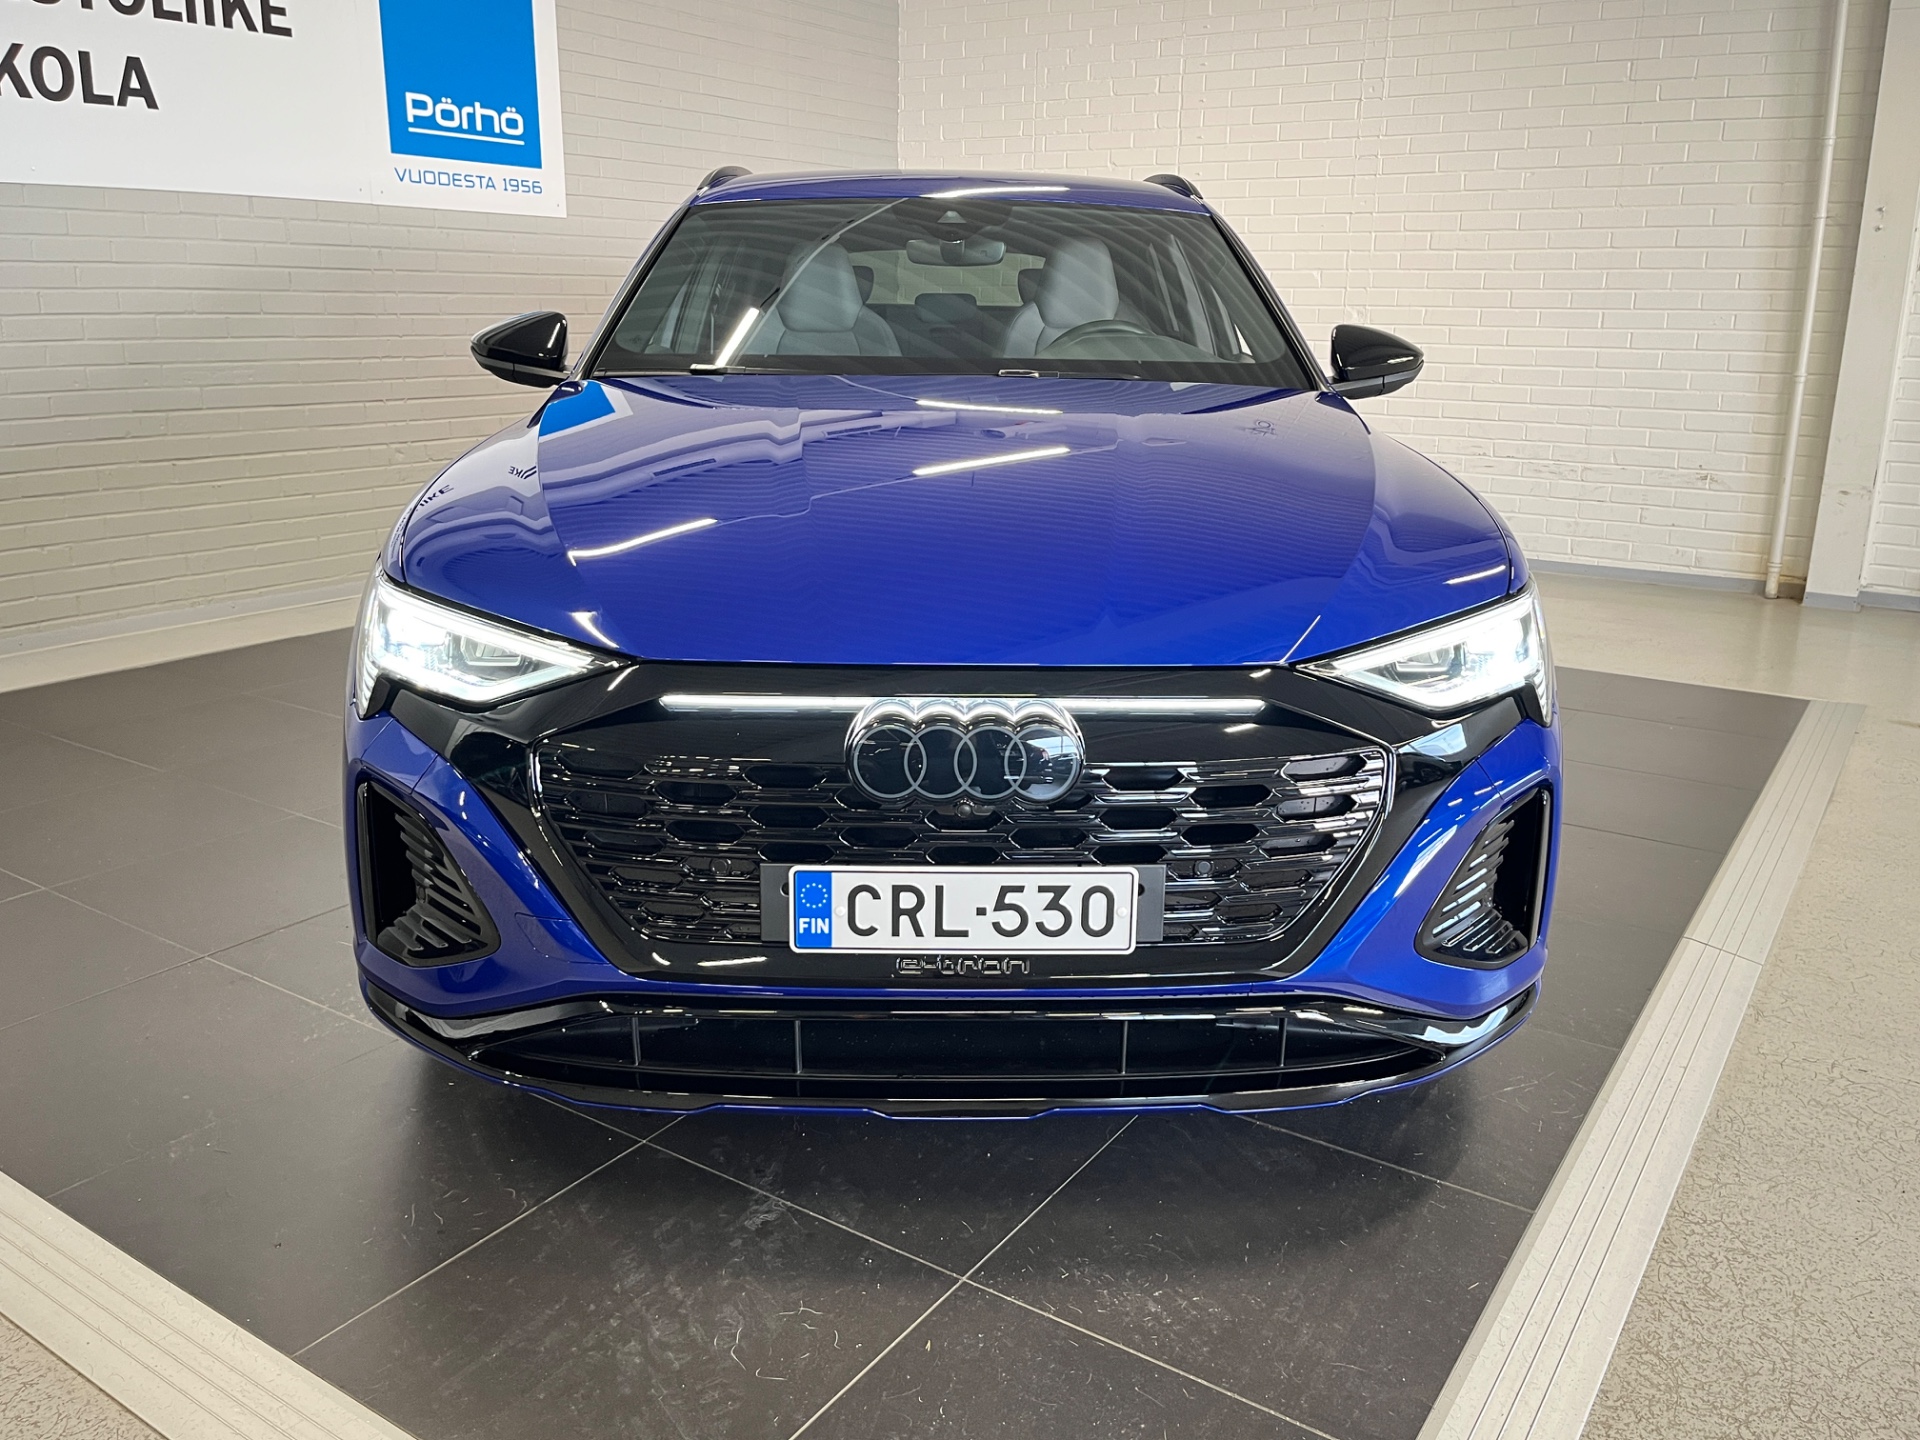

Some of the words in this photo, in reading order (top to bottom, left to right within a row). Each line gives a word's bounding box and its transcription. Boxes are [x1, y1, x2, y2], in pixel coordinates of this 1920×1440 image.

[405, 91, 524, 136] Pörhö
[394, 167, 497, 191] VUODESTA
[502, 177, 543, 195] 1956
[799, 917, 829, 935] FIN
